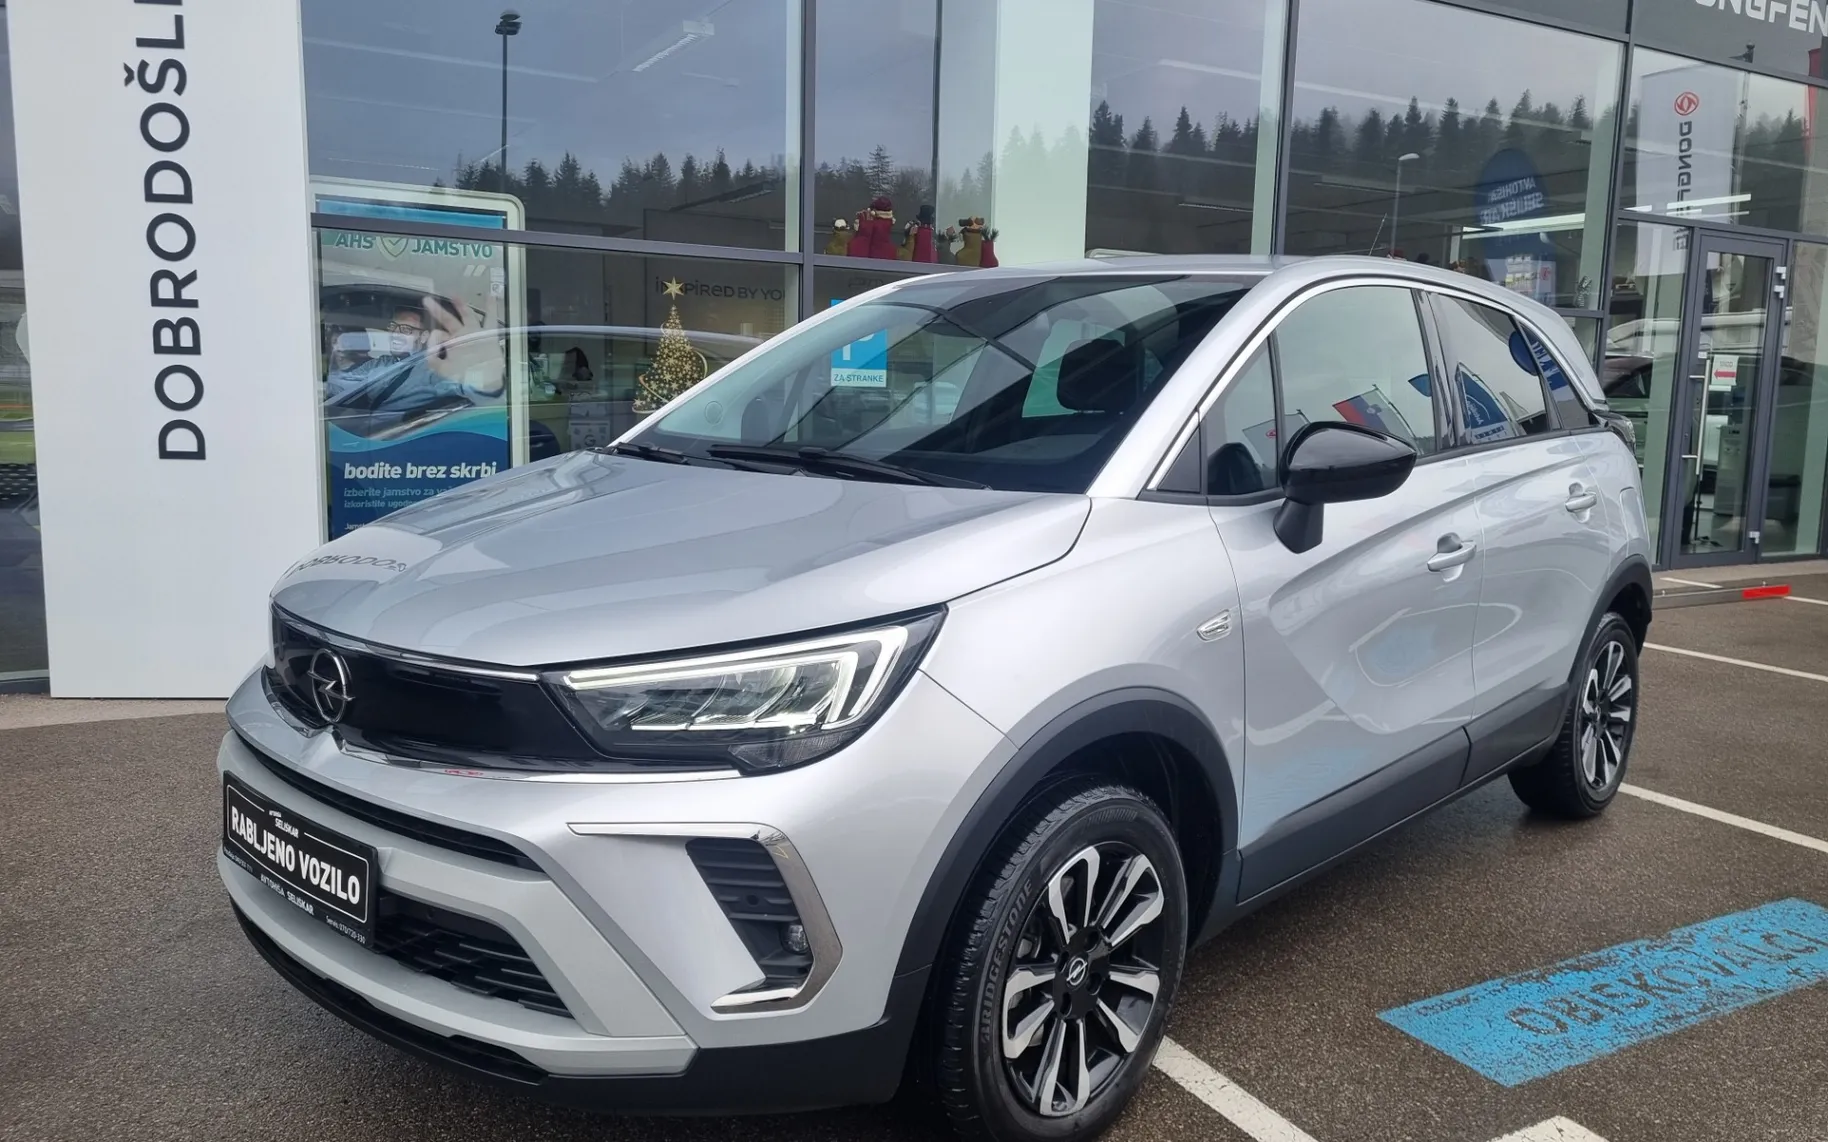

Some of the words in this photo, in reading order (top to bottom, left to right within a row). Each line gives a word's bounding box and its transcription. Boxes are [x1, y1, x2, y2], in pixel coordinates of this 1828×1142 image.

[335, 232, 375, 249] AHS
[412, 238, 494, 258] JAMSTVO
[738, 286, 758, 299] BY
[761, 288, 786, 301] YO
[846, 374, 884, 382] STRANKE
[344, 461, 402, 479] bodite
[406, 461, 447, 479] brez
[450, 461, 498, 478] skrbi
[344, 487, 381, 497] izberite
[382, 487, 421, 498] jamstvo
[423, 488, 435, 496] za
[231, 805, 296, 872] RABLJENO
[299, 849, 361, 905] VOZILO
